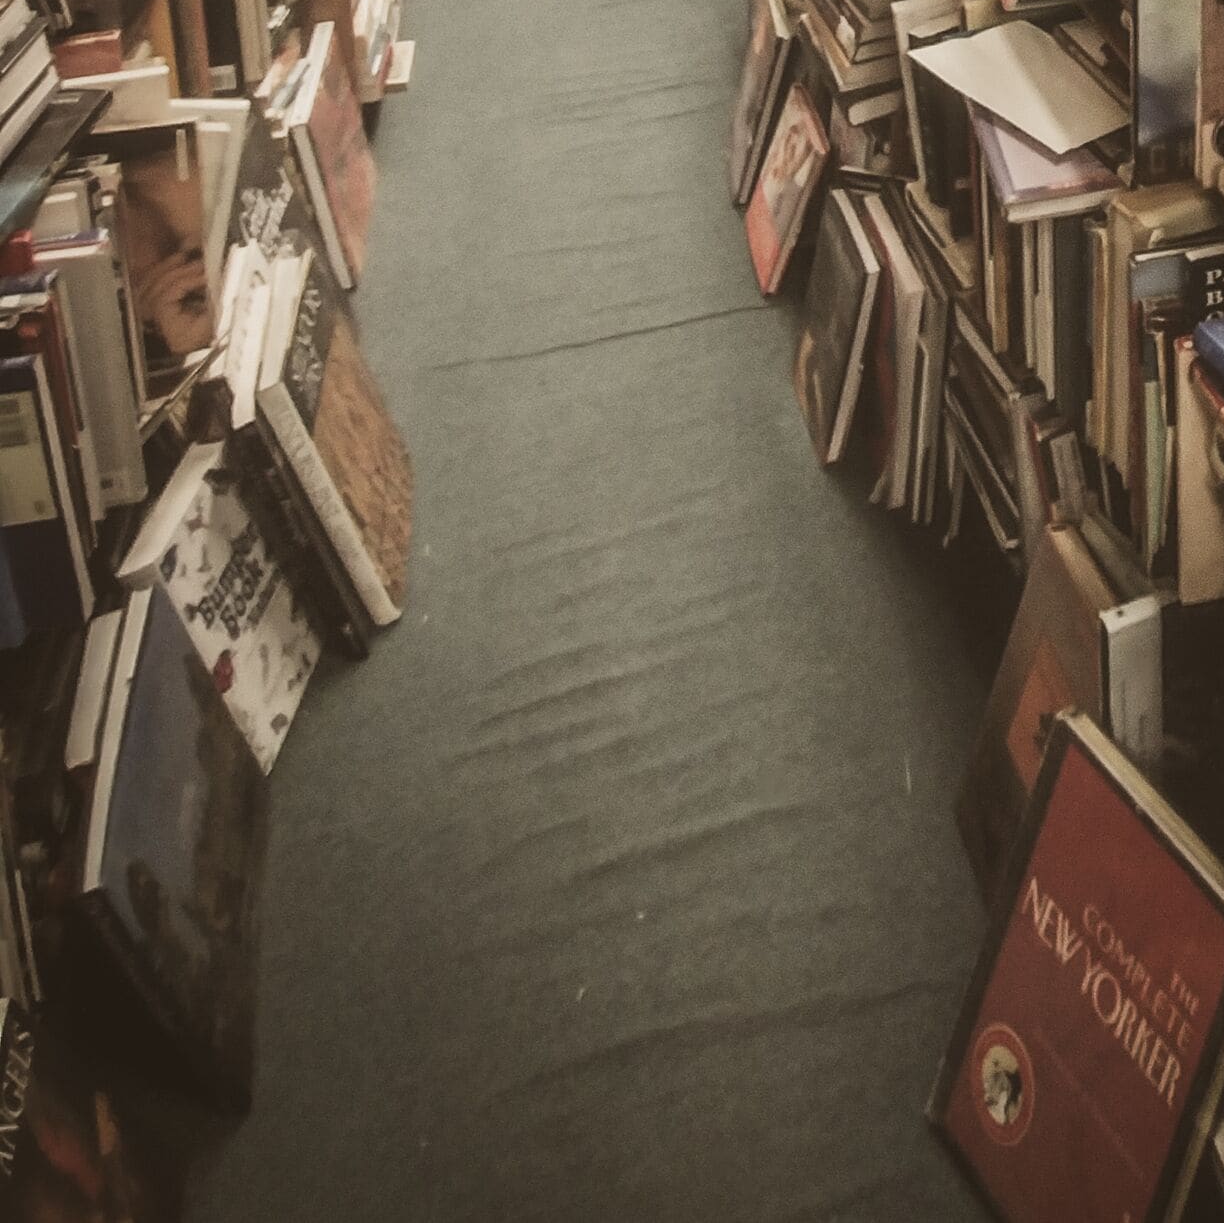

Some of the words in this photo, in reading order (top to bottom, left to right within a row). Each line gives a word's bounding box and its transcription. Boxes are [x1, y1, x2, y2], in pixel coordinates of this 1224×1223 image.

[1021, 876, 1083, 965] NEW
[1082, 903, 1194, 1050] COMPLETE
[1080, 945, 1182, 1107] YORKER
[1170, 972, 1201, 1017] THE
